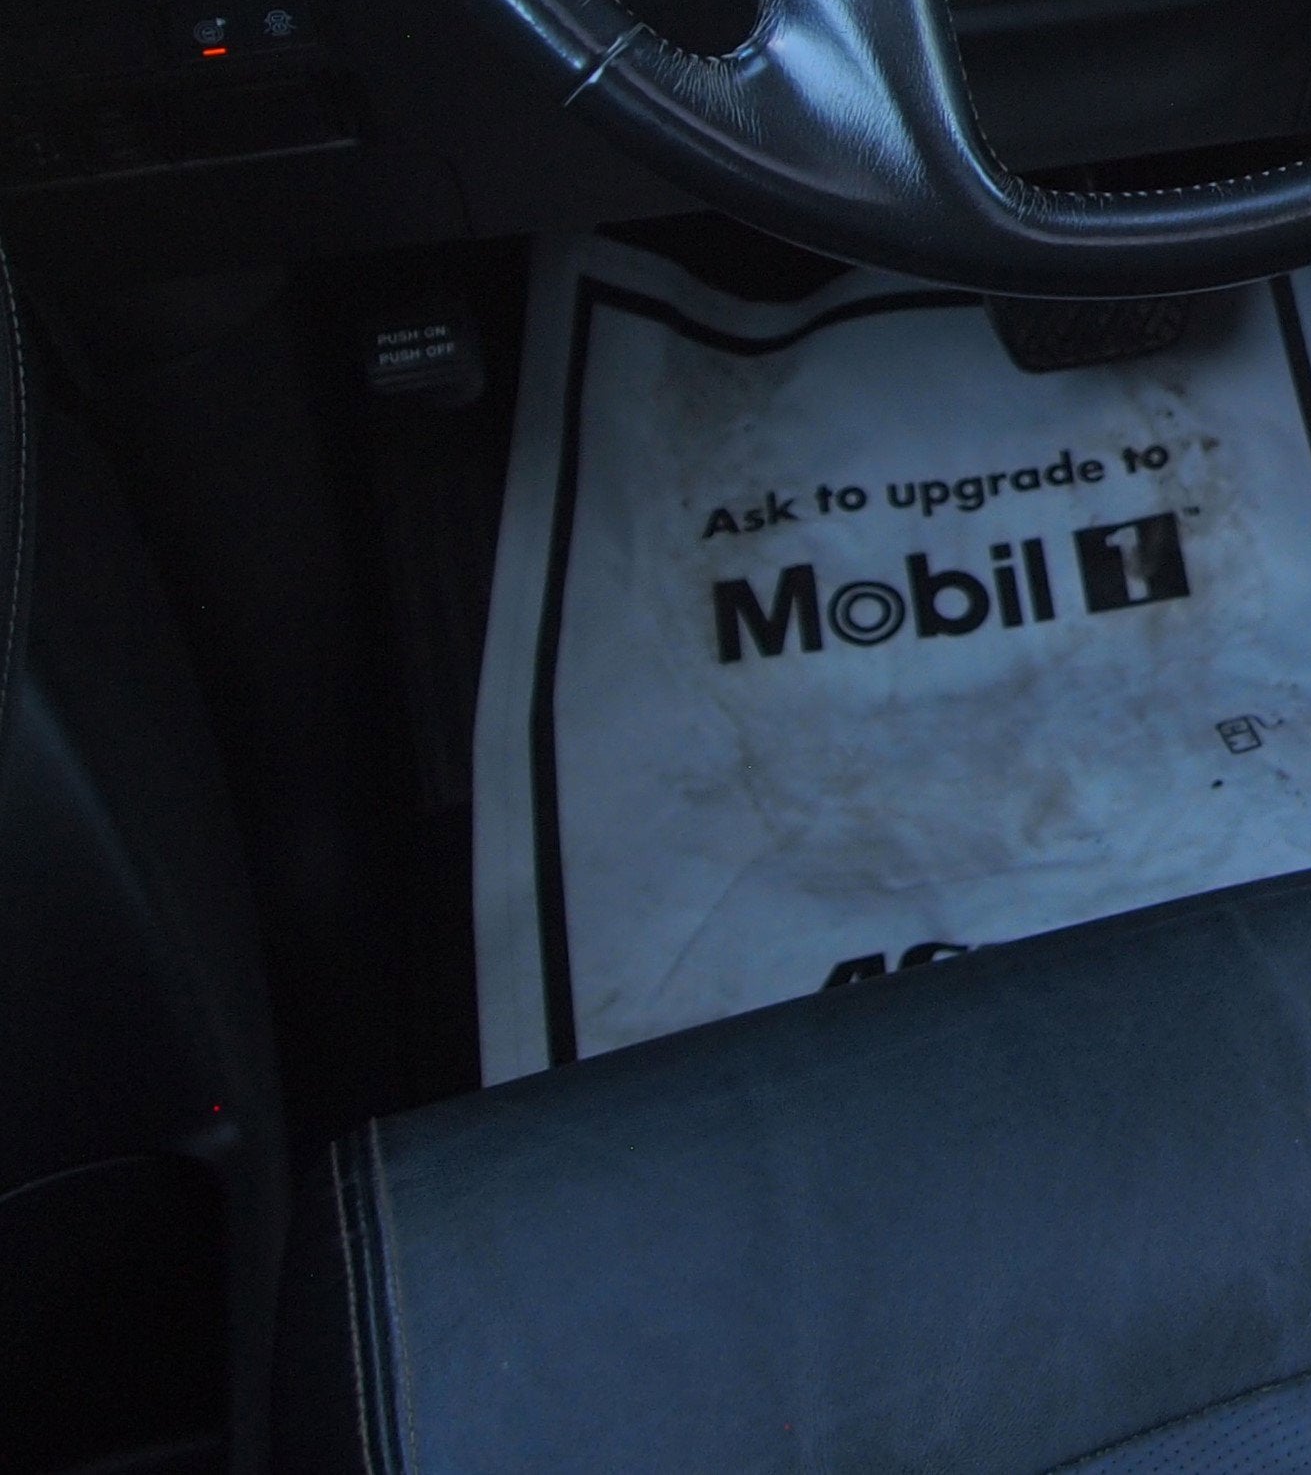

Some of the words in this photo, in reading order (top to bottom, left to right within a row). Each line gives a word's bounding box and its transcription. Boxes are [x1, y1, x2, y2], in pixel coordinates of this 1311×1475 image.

[379, 348, 420, 365] PUSH
[702, 490, 800, 539] Ask
[815, 483, 868, 515] to
[886, 448, 1104, 517] upgrade
[1121, 443, 1170, 474] to
[713, 537, 1056, 664] Mobil
